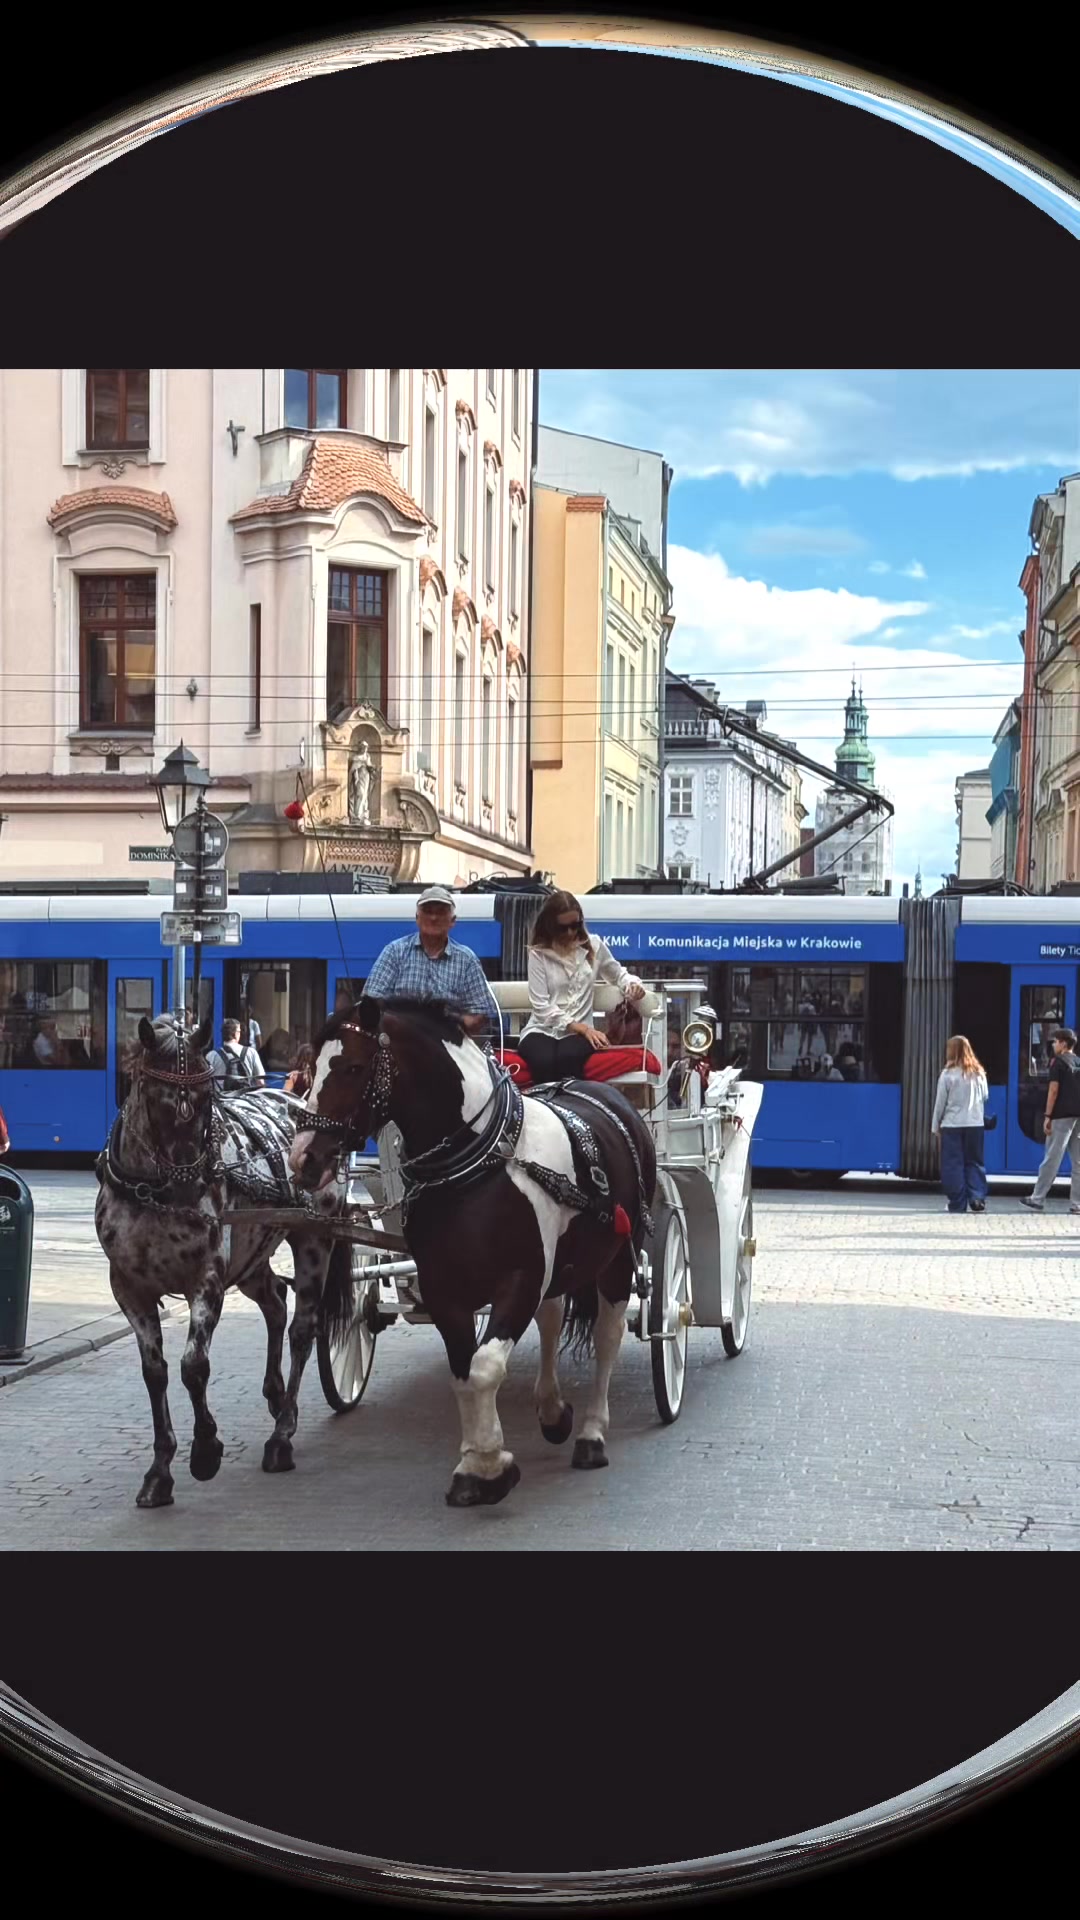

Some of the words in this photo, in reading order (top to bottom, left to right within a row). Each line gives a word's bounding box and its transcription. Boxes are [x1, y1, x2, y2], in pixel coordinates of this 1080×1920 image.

[130, 852, 176, 860] DOMINIKA
[603, 935, 630, 947] KMK
[648, 935, 730, 950] Komunikacja
[733, 935, 783, 951] Miejska
[786, 938, 798, 949] w
[800, 936, 862, 949] Krakowie
[1040, 945, 1066, 957] Bilety
